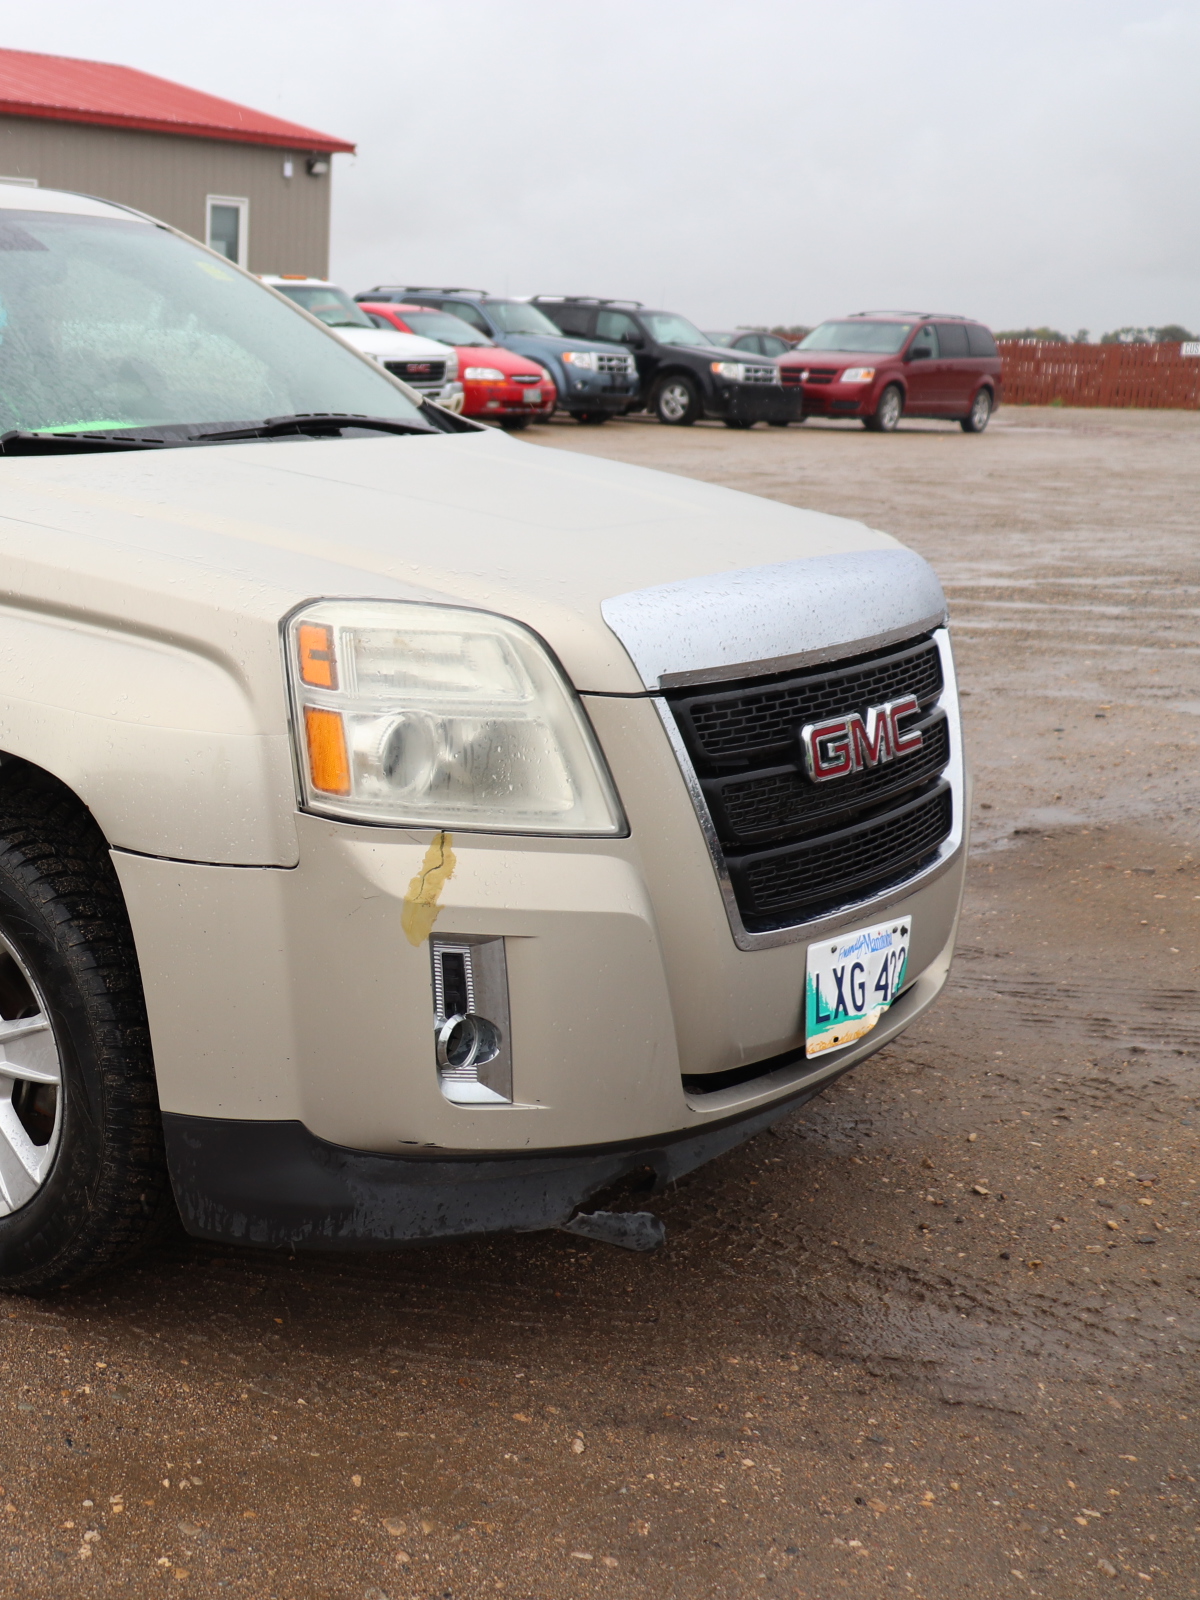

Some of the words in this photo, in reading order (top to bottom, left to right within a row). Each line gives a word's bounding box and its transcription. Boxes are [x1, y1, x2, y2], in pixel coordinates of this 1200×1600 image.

[406, 364, 431, 373] GMC
[801, 693, 923, 784] GMC
[815, 961, 866, 1025] LXG
